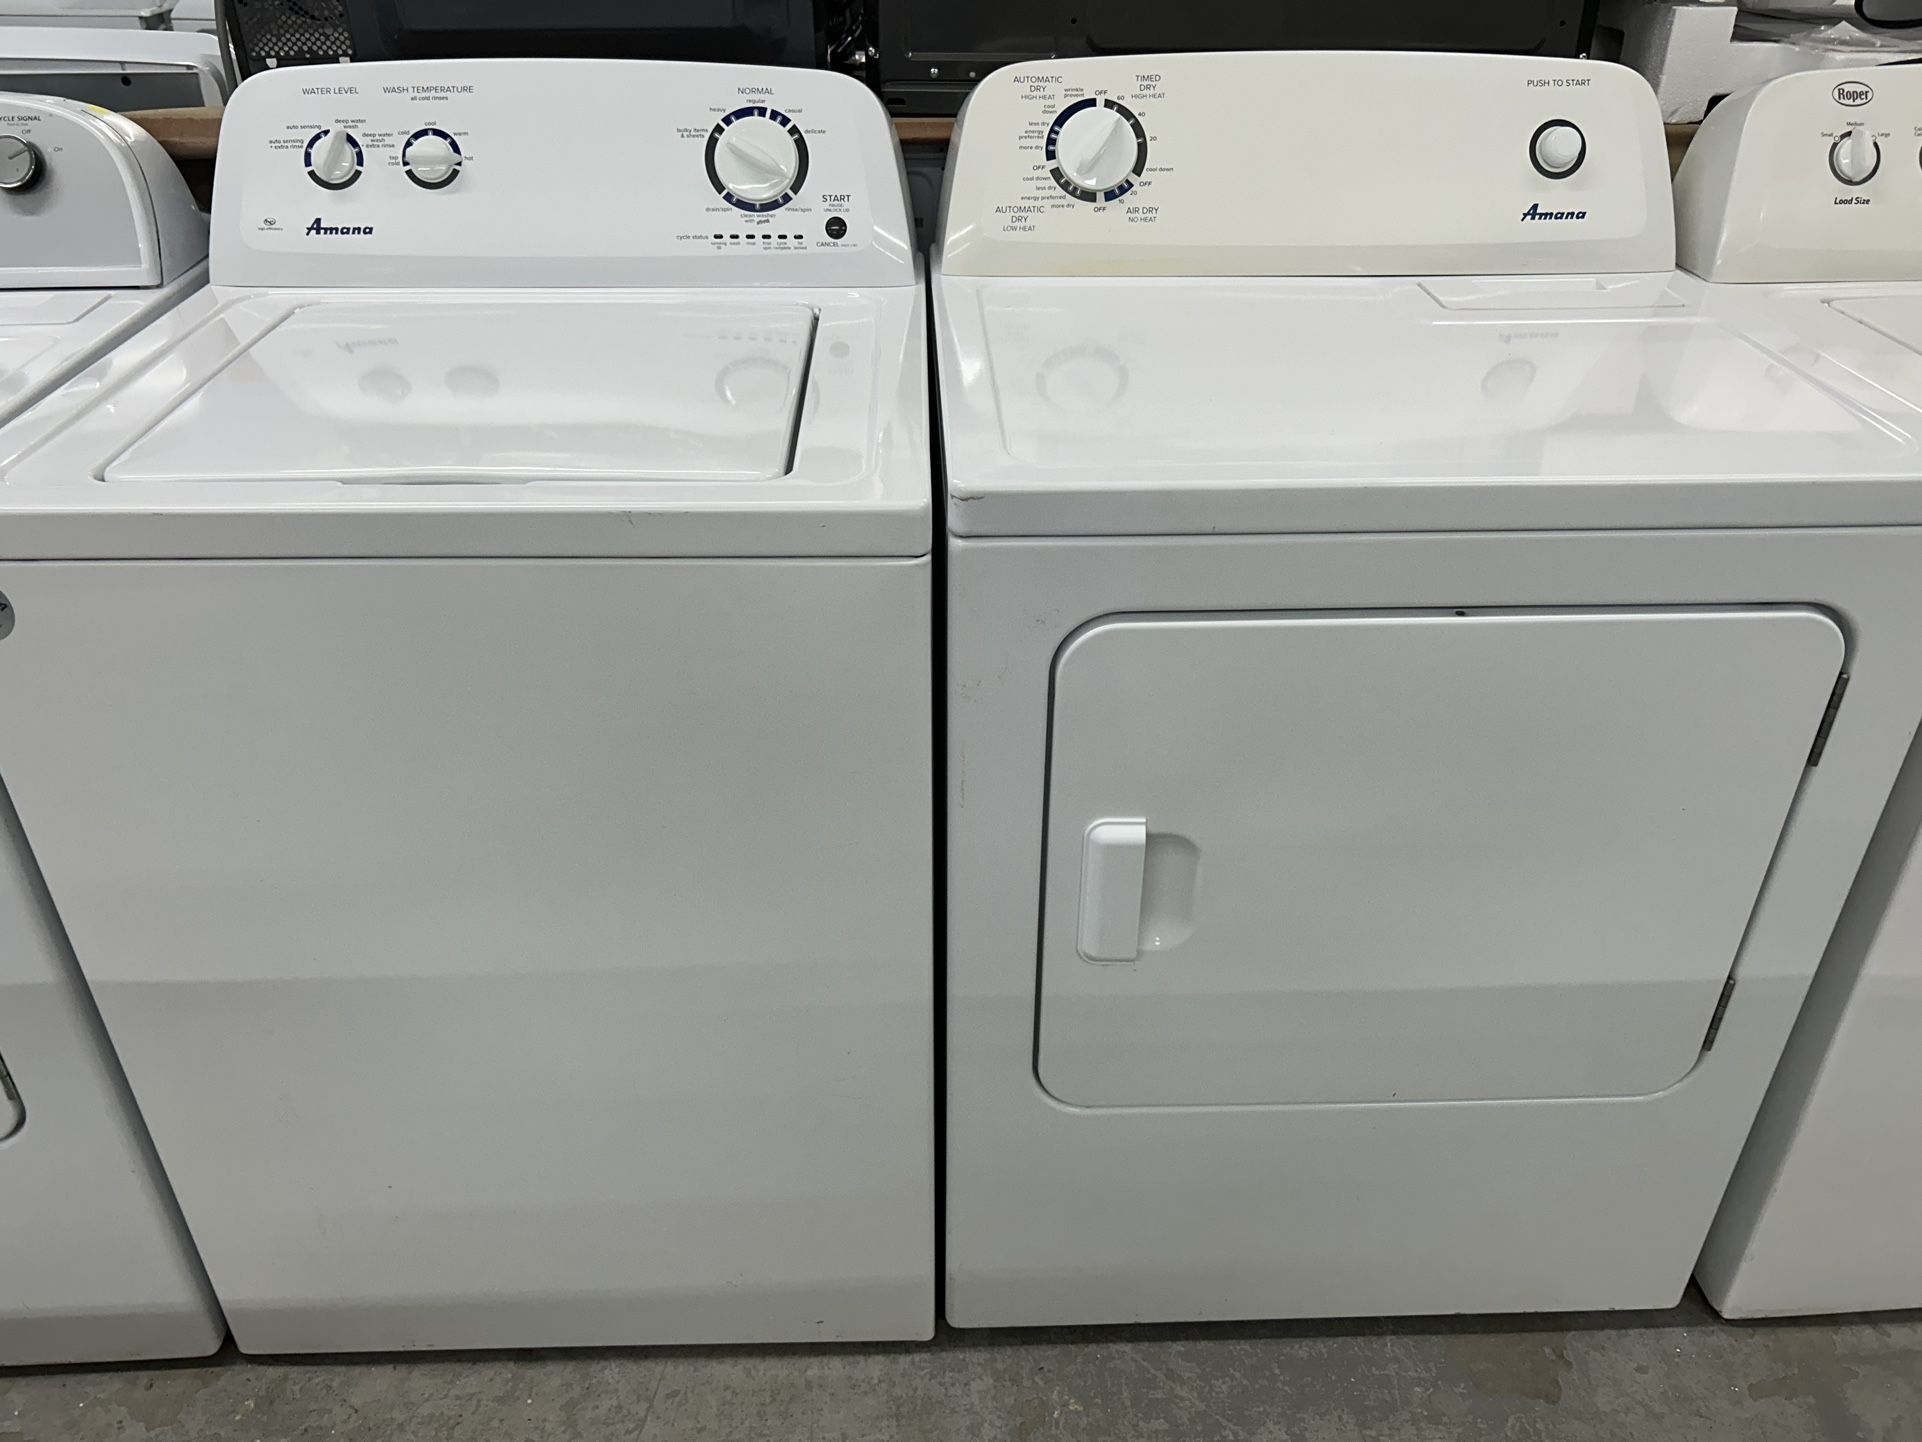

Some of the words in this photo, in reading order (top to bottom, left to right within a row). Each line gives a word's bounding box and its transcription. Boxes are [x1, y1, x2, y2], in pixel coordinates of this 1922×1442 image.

[1552, 79, 1564, 87] TO
[1566, 79, 1591, 87] START
[737, 87, 775, 95] NORMAL
[1837, 88, 1870, 103] Roper
[822, 194, 851, 202] START
[1834, 197, 1853, 205] Load
[1854, 197, 1870, 205] Size
[1520, 203, 1587, 222] Amana
[305, 217, 374, 236] Amana
